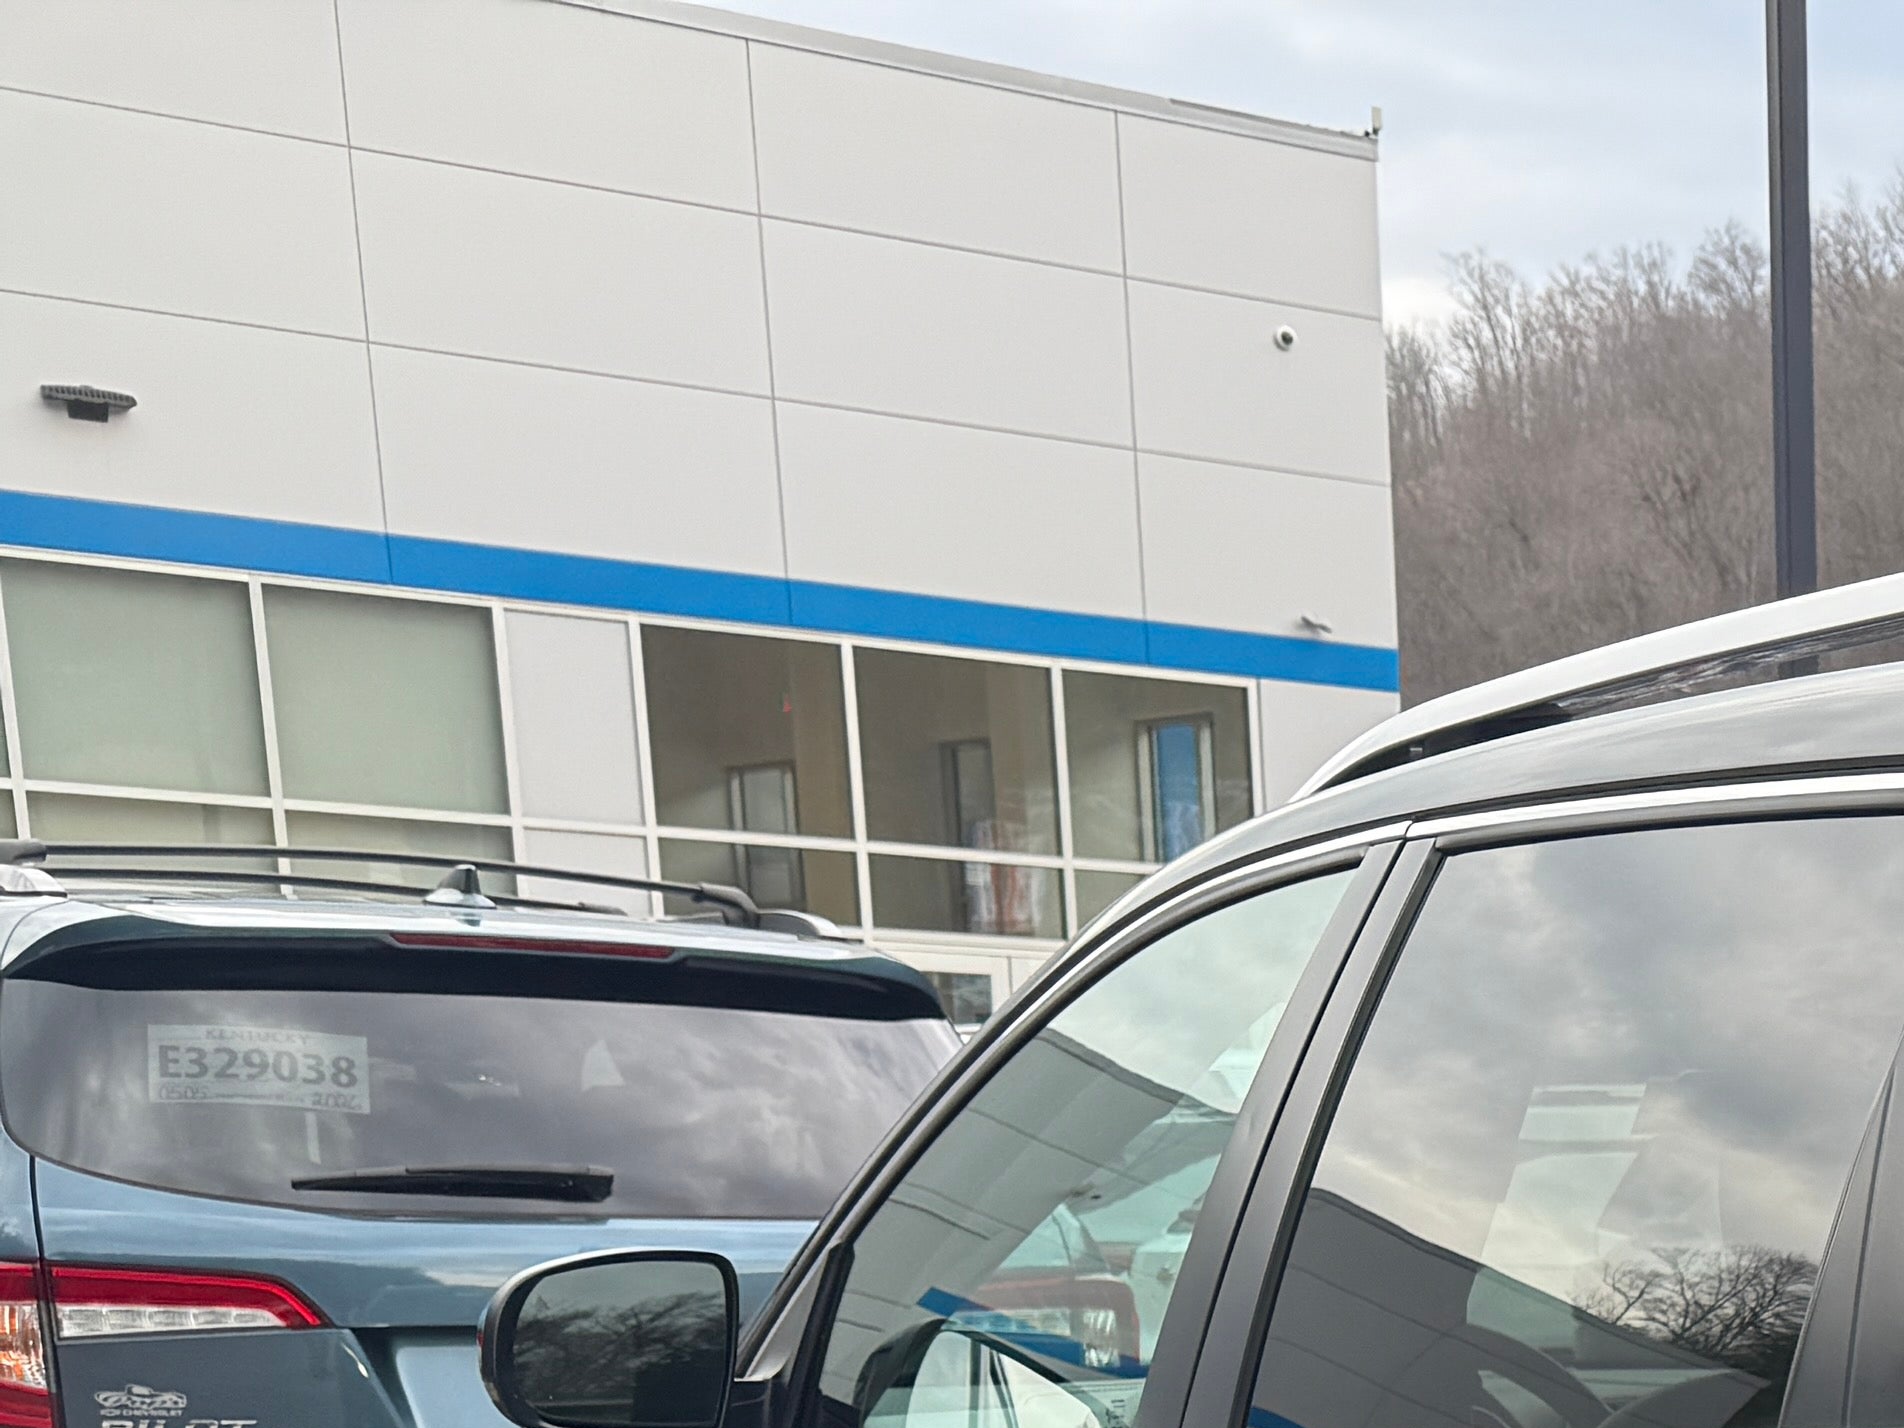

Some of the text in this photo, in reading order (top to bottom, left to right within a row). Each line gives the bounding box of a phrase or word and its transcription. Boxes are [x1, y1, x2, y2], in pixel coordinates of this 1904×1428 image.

[205, 1028, 310, 1045] KENTUCKY
[158, 1045, 358, 1088] E329038
[122, 1408, 183, 1417] CHEVROLET
